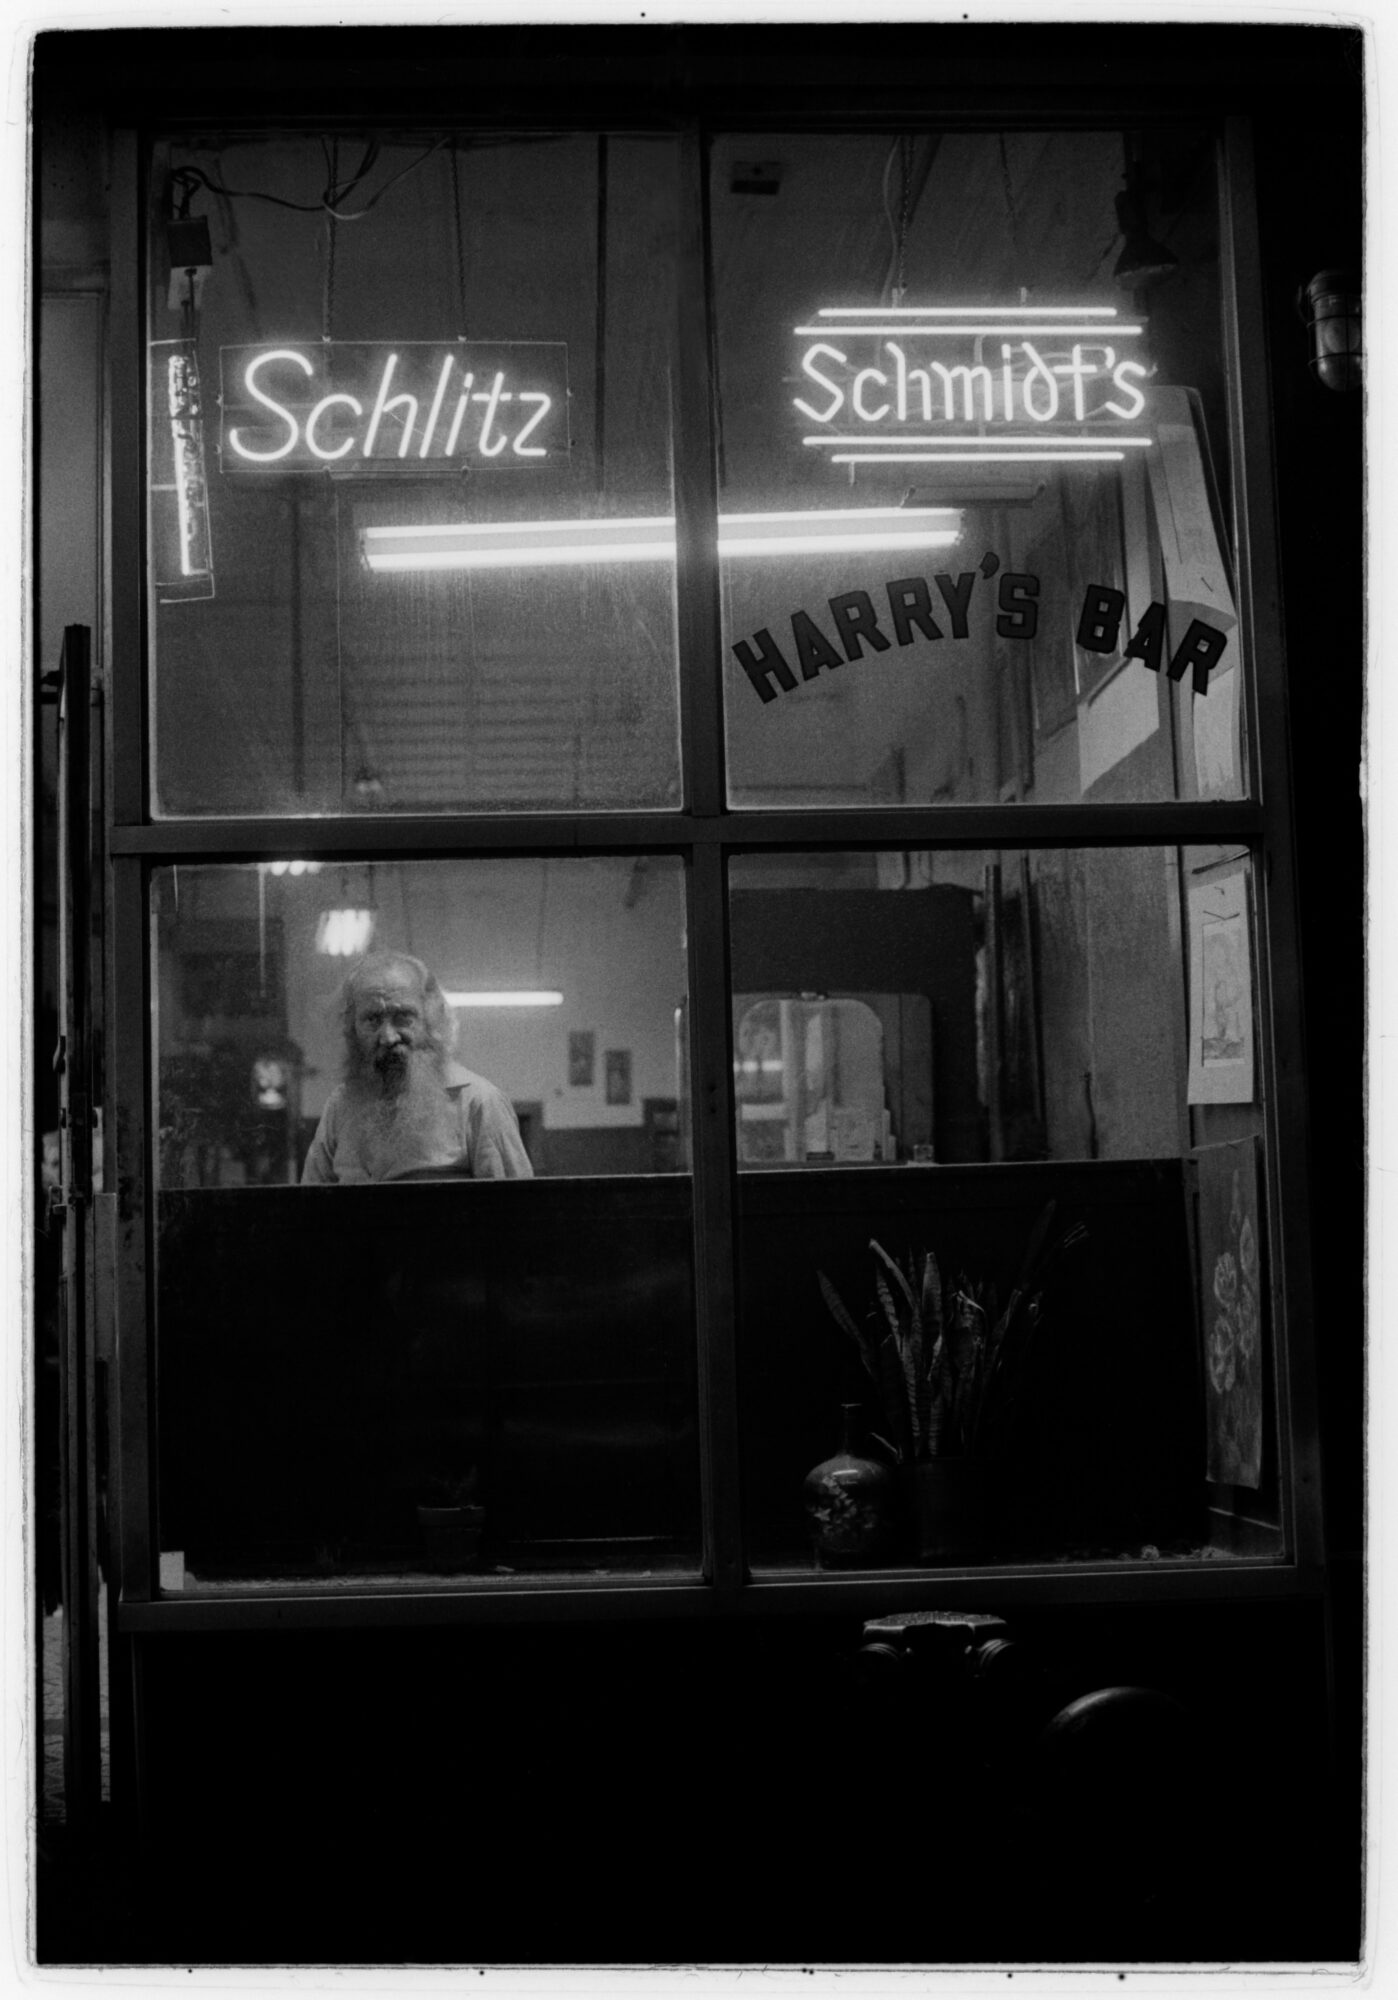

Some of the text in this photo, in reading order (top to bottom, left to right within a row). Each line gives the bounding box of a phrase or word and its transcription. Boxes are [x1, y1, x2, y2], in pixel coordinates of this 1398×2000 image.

[229, 350, 552, 461] Schlitz
[794, 342, 1145, 421] Schmidt's
[731, 551, 1228, 704] HARRY'S BAR
